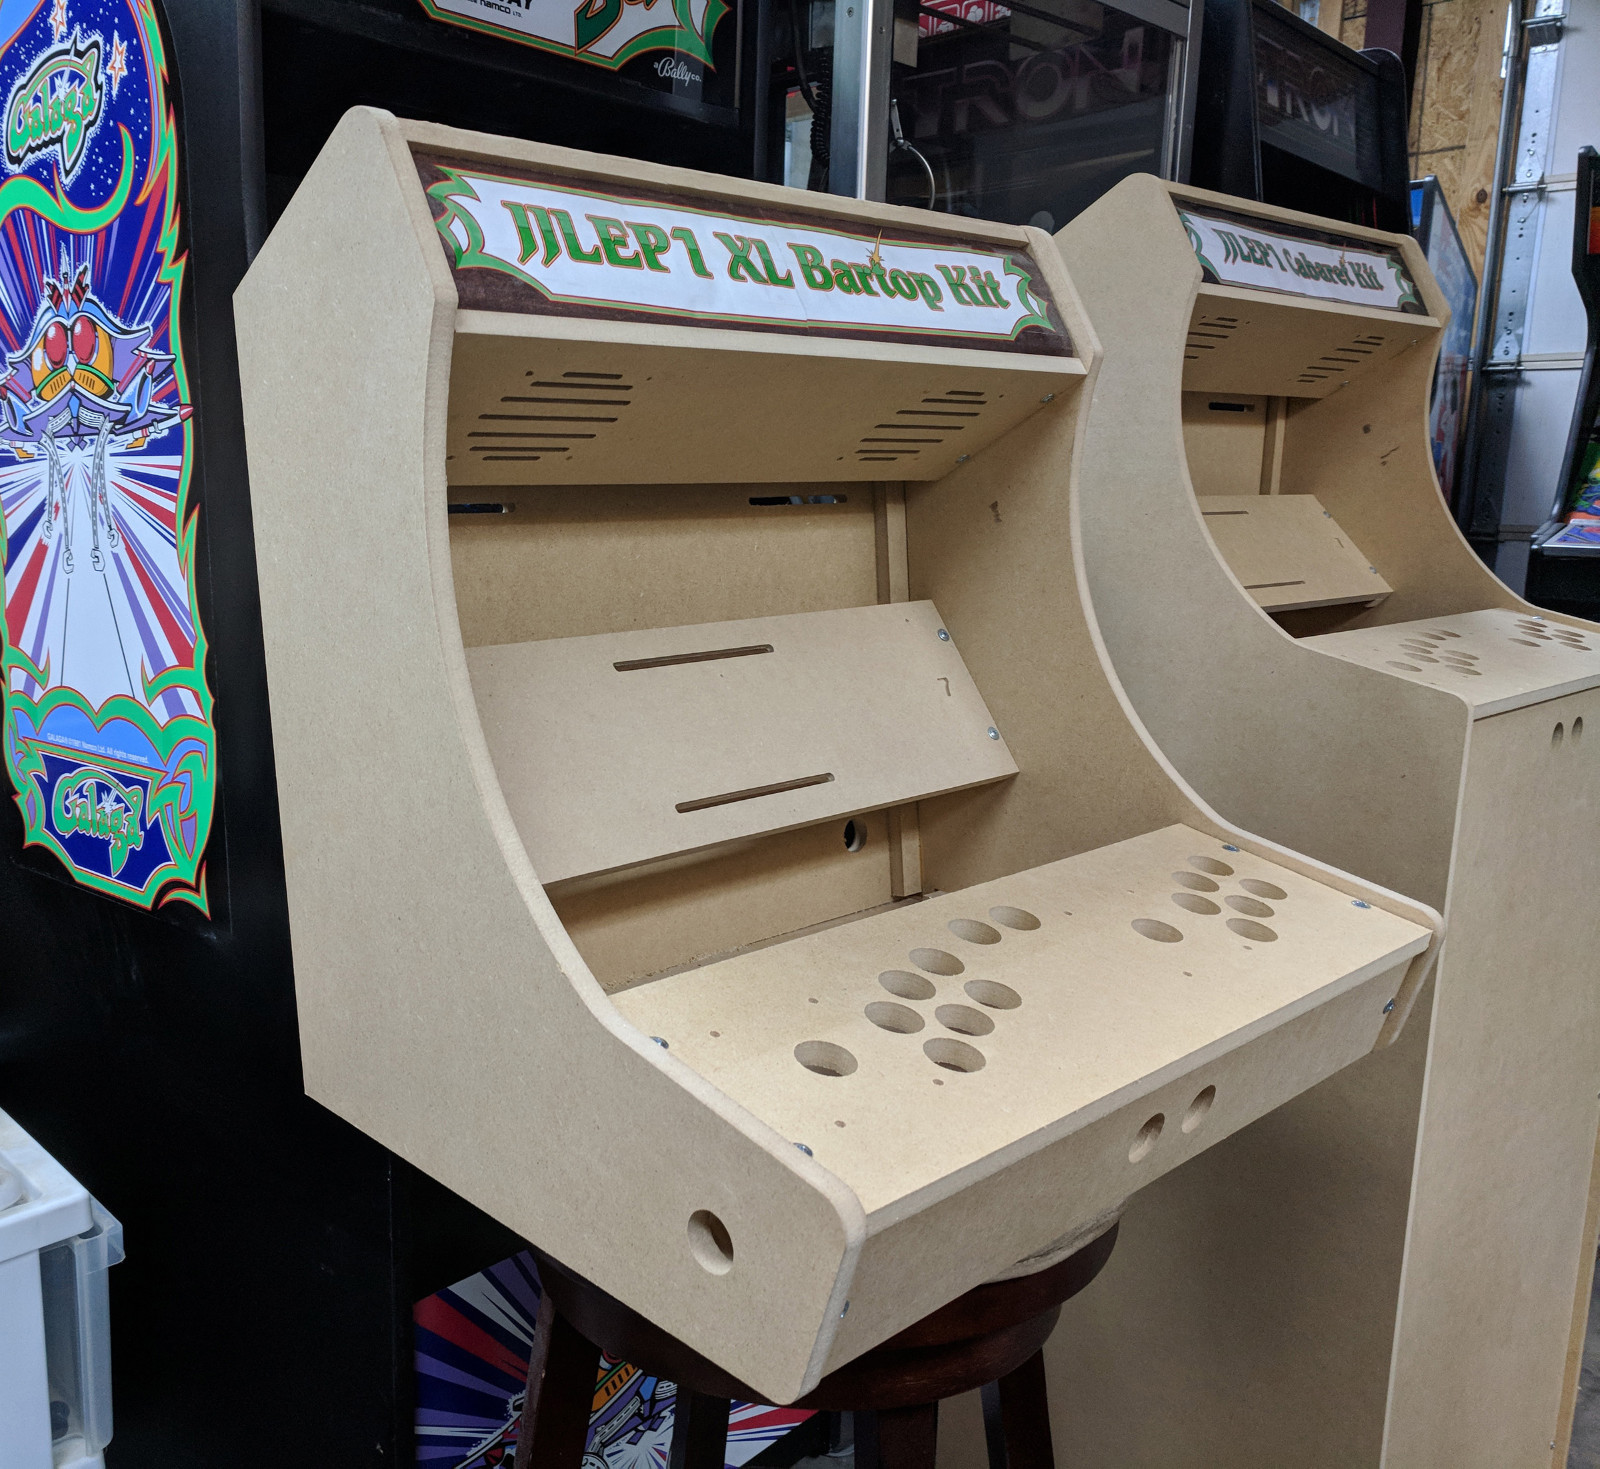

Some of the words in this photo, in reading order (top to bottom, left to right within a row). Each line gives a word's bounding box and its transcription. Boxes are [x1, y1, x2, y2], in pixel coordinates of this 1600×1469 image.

[8, 51, 98, 164] Galaga
[658, 56, 691, 87] Bally
[903, 26, 1145, 138] TRON
[712, 230, 796, 290] XL
[786, 241, 946, 313] Bartop
[934, 263, 1011, 310] Kit
[1282, 247, 1356, 288] Cabaret
[1347, 260, 1385, 291] Kit
[53, 767, 145, 877] Galaga
